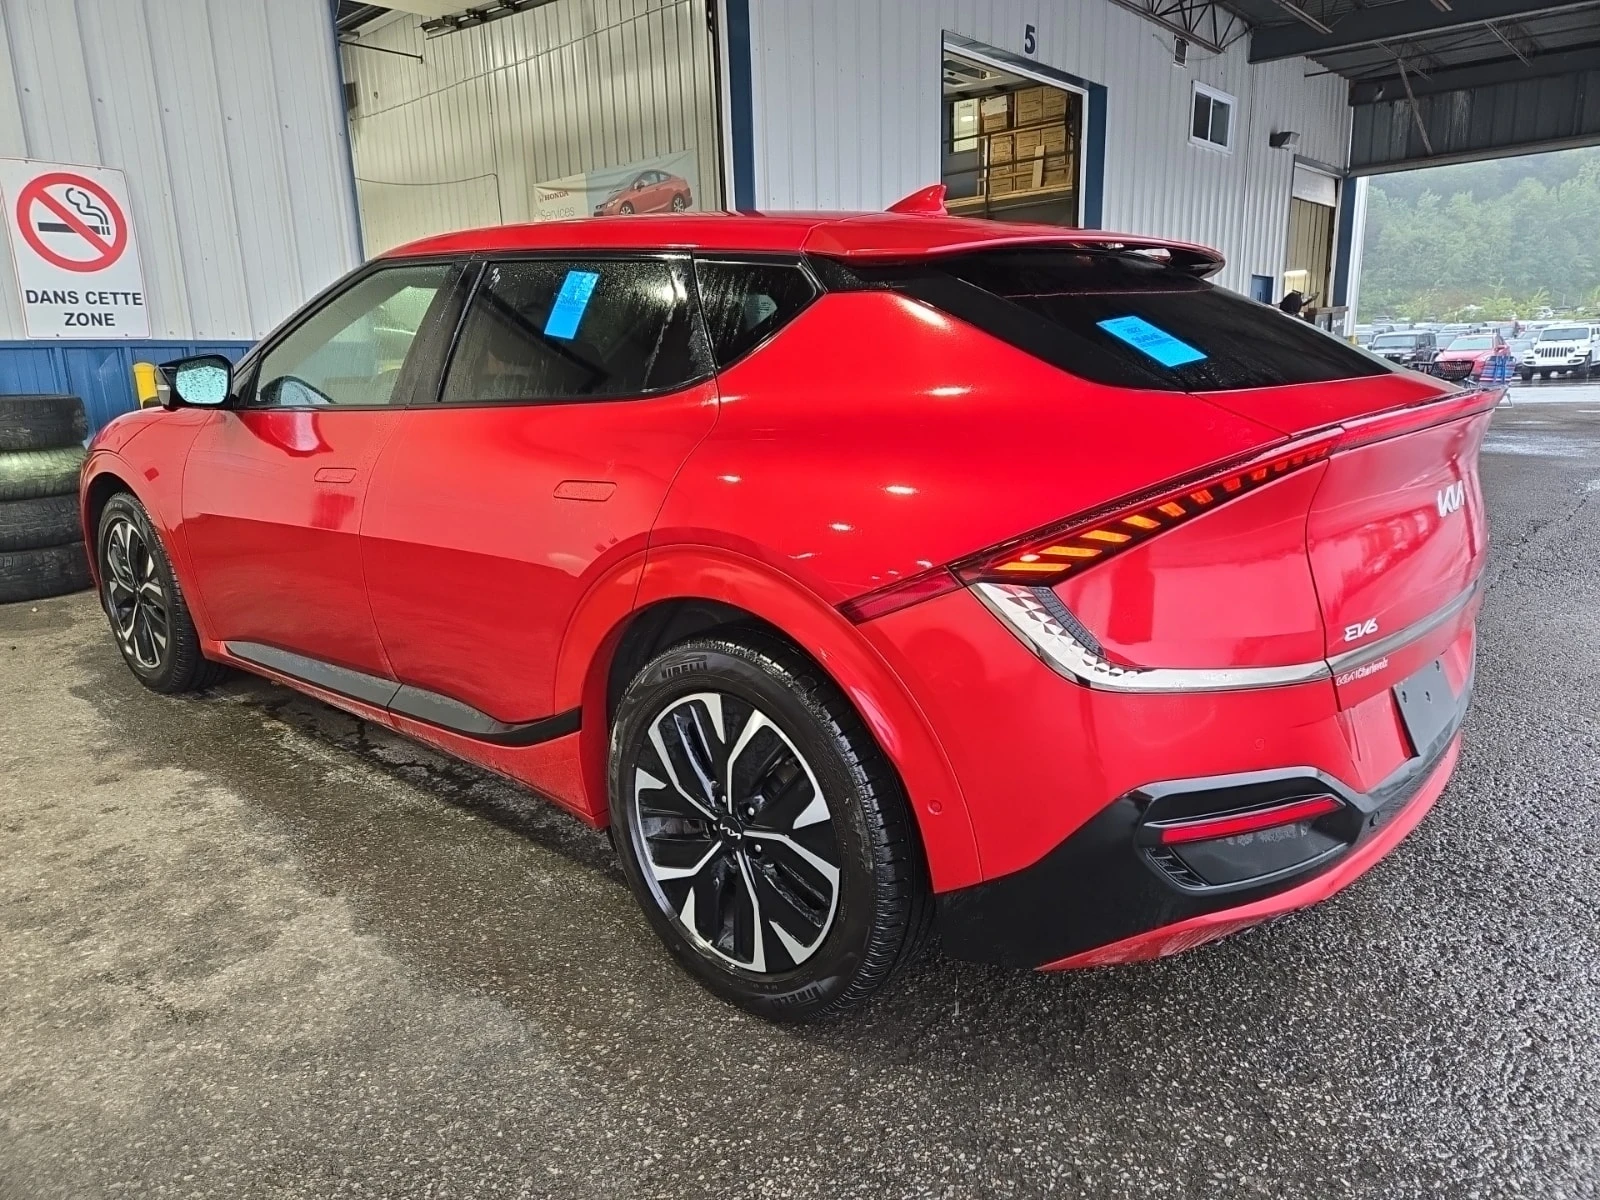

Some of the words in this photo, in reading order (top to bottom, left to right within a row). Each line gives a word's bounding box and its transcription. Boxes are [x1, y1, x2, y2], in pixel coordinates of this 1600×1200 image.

[1024, 24, 1036, 54] 5
[544, 190, 569, 201] HONDA
[540, 206, 575, 220] Services
[25, 289, 79, 305] DANS
[85, 291, 143, 305] CETTE
[64, 312, 116, 326] ZONE
[1344, 617, 1379, 641] EV6
[660, 654, 708, 679] PIRELLI
